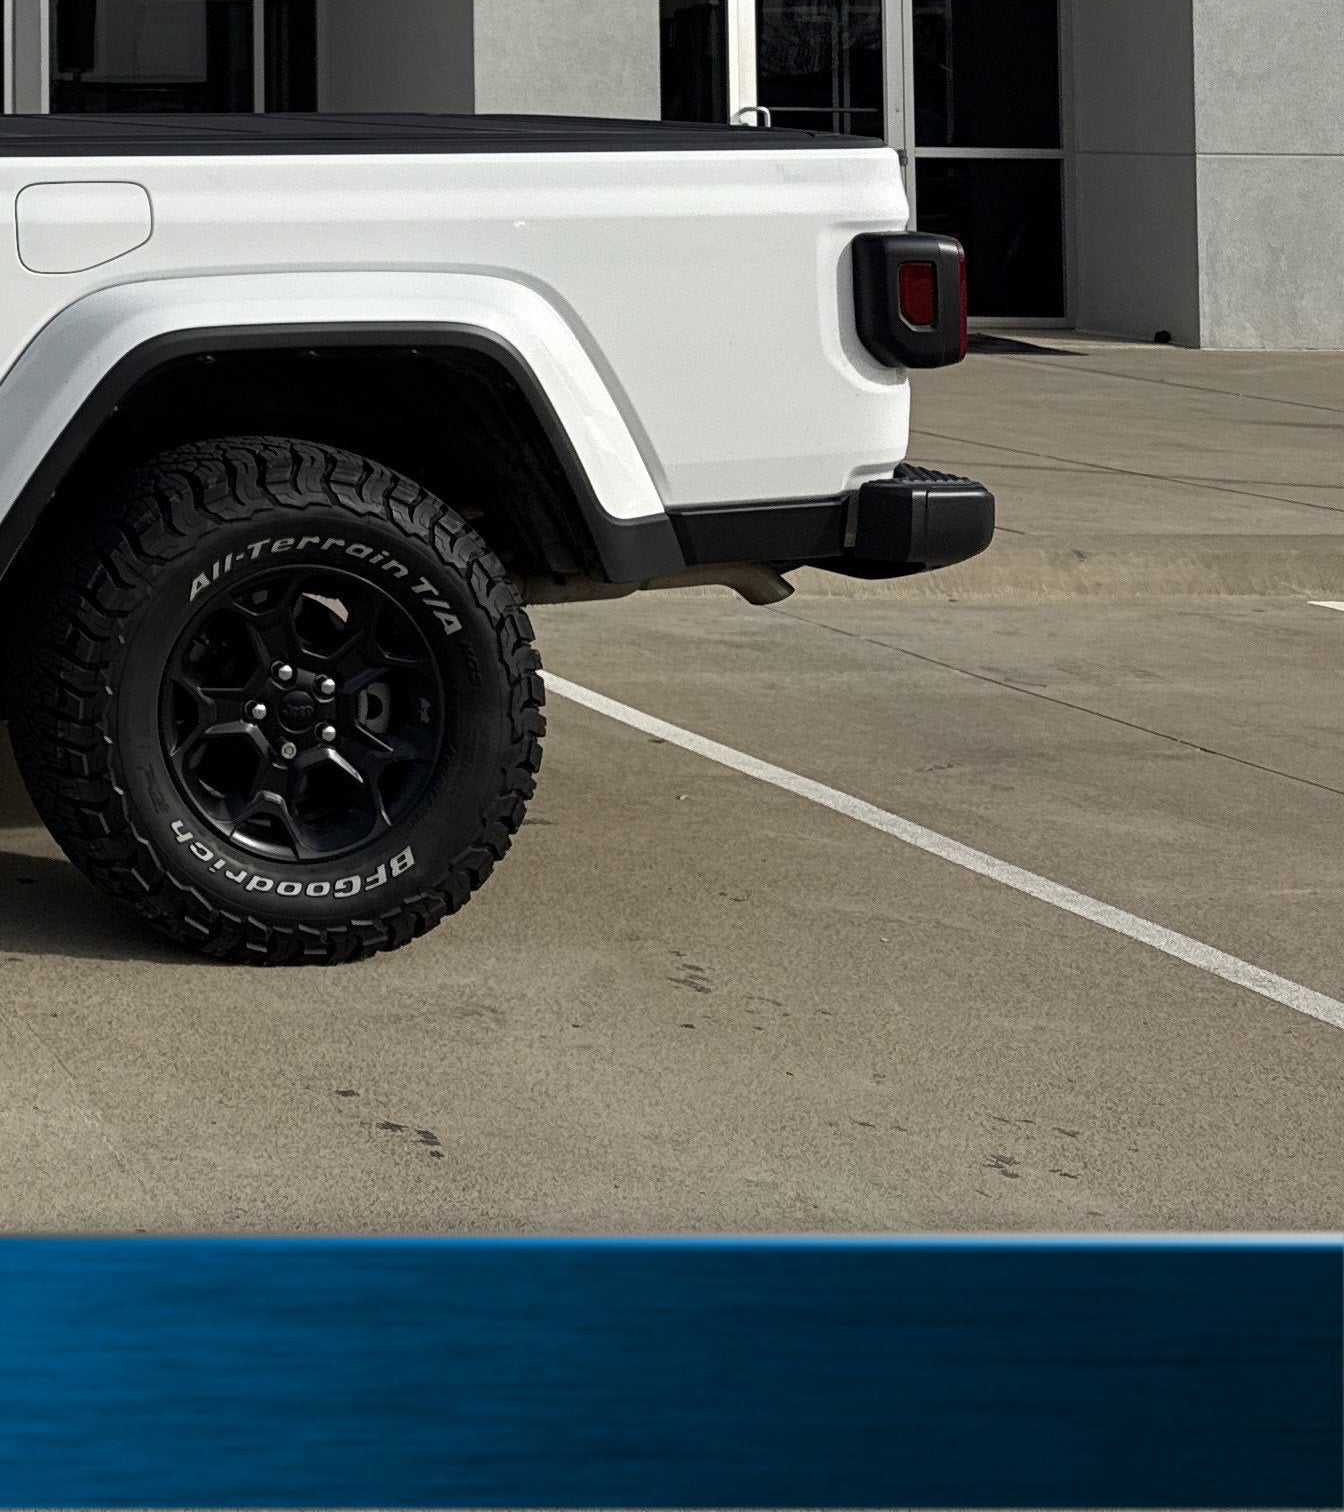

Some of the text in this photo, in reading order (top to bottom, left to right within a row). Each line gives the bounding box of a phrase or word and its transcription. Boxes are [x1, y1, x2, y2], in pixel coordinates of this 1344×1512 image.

[189, 534, 463, 636] All-Terrain T/A
[170, 818, 416, 899] BFGoodrich
